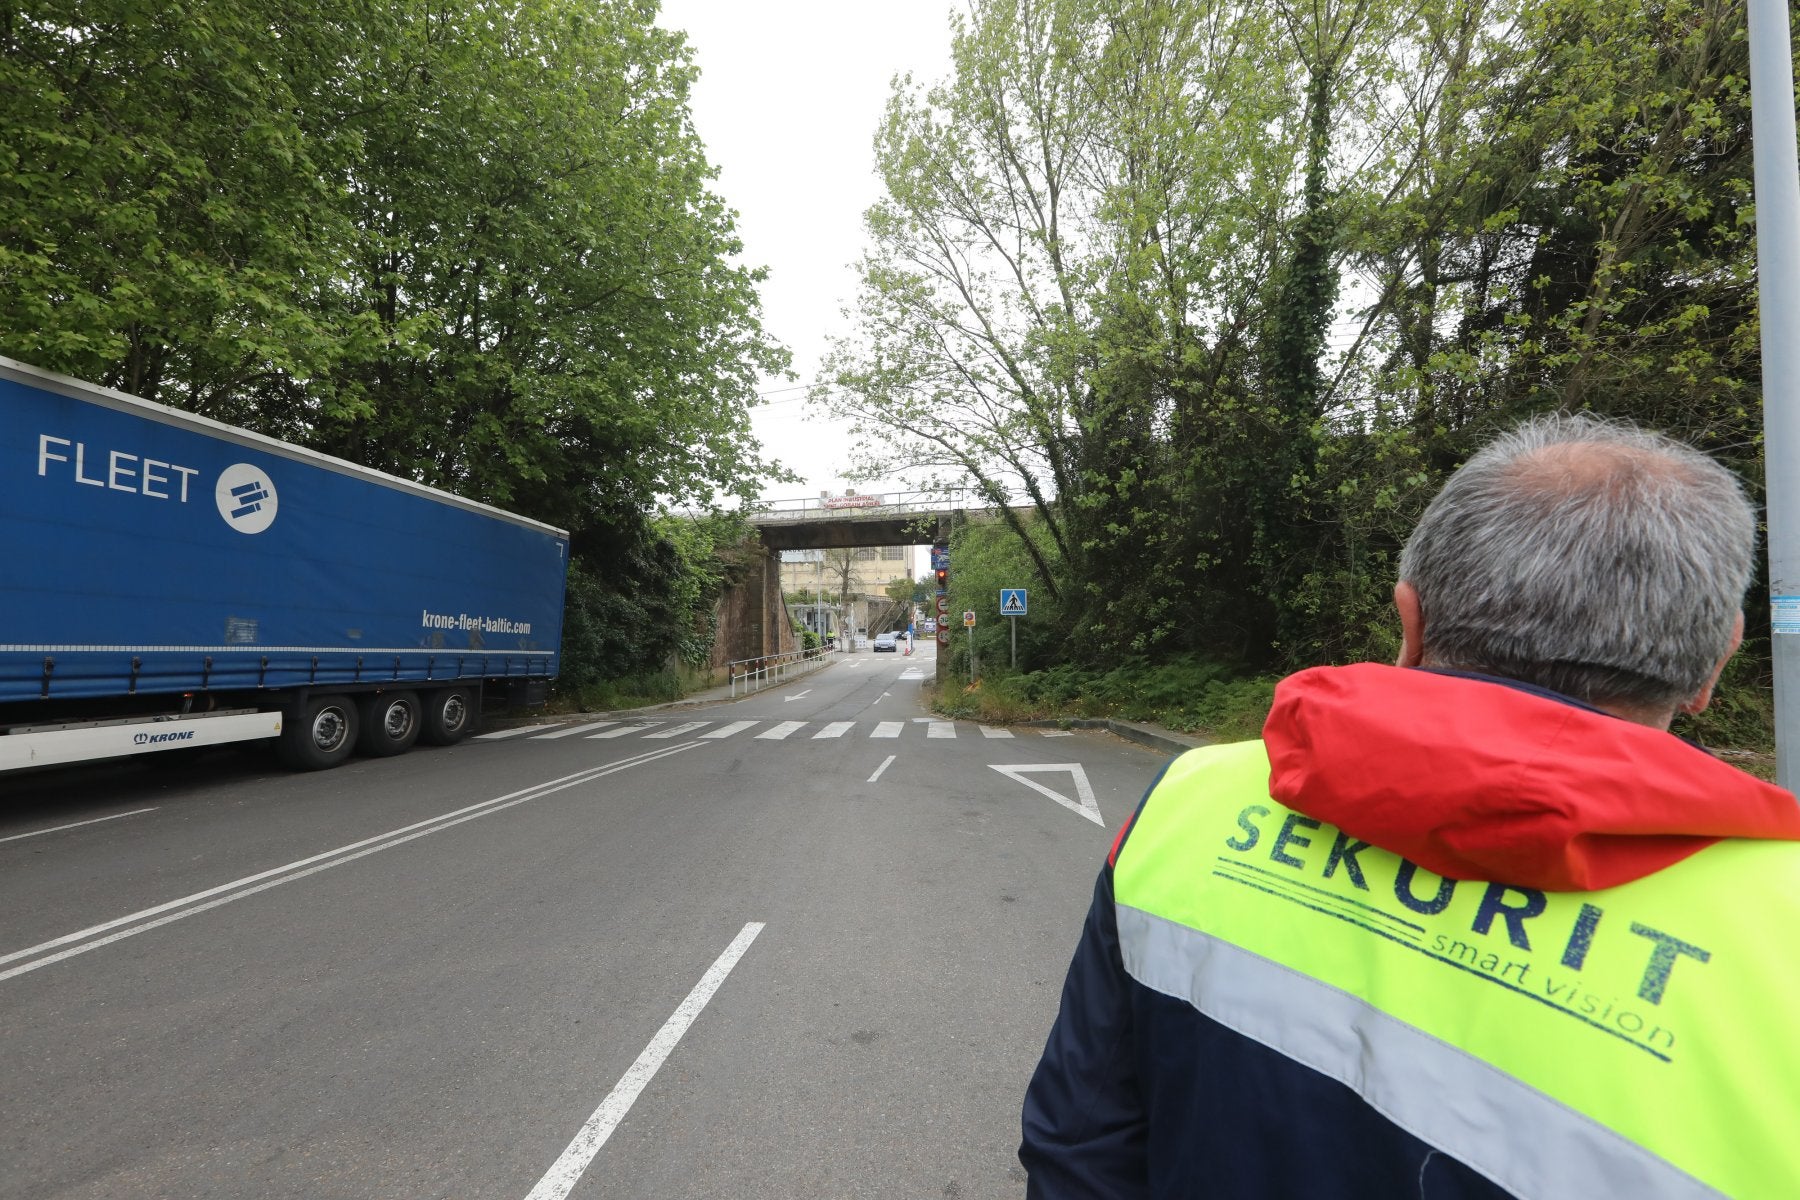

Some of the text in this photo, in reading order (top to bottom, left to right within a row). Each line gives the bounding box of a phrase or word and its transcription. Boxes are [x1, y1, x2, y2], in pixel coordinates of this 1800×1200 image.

[37, 434, 199, 504] FLEET
[421, 610, 532, 636] krone-fleet-baltic.com
[149, 731, 195, 743] KRONE
[1225, 805, 1712, 1006] SEKURIT
[1430, 932, 1677, 1049] smart vision
